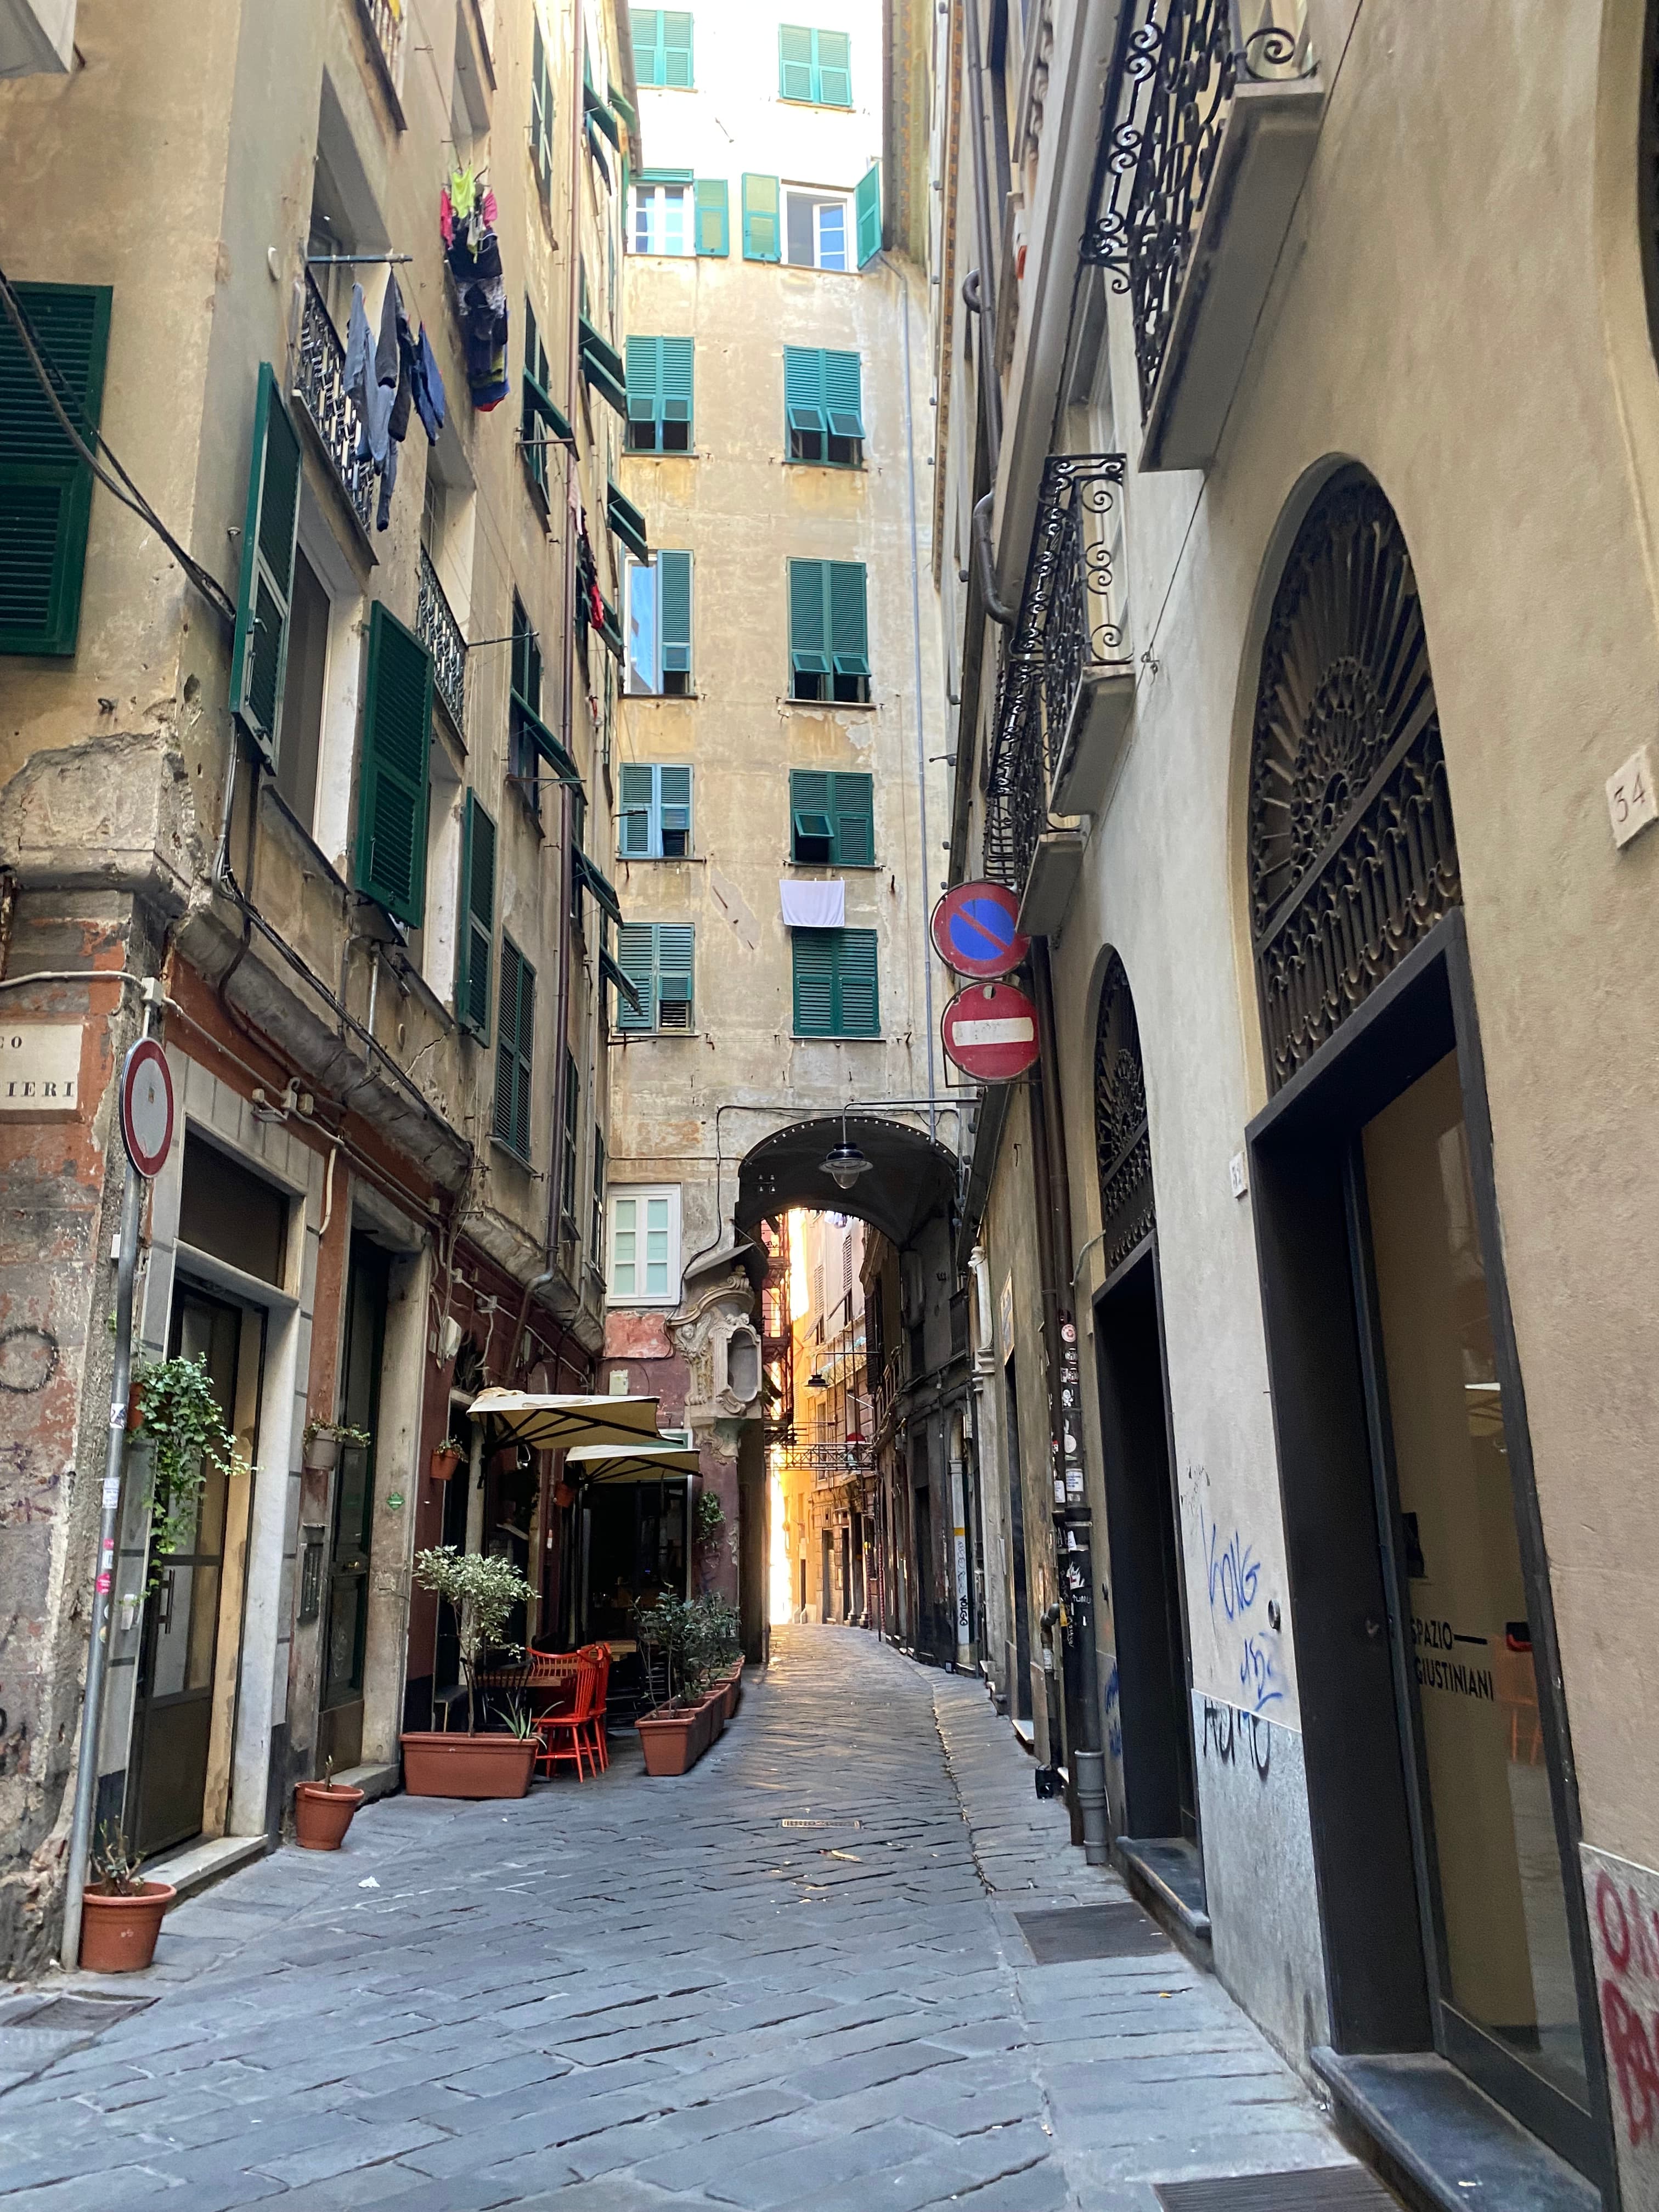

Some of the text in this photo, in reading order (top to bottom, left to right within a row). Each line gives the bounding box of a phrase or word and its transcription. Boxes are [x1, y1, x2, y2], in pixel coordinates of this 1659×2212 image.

[0, 1081, 75, 1097] IERI
[1410, 1618, 1453, 1650] SPAZIO
[1414, 1656, 1495, 1701] GIUSTINIANI
